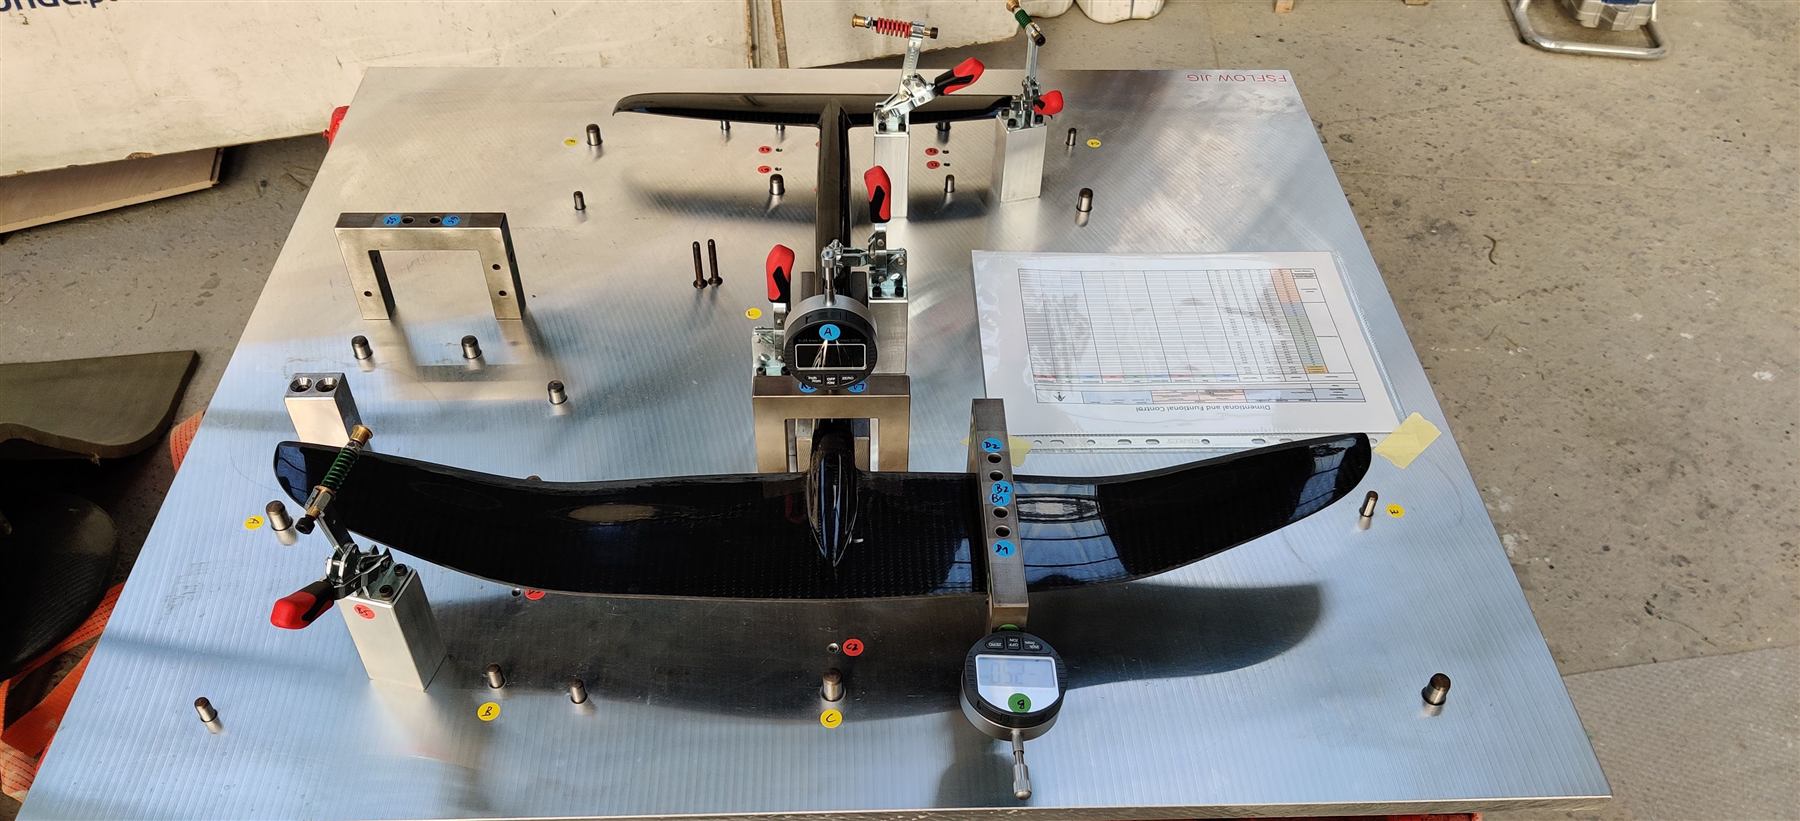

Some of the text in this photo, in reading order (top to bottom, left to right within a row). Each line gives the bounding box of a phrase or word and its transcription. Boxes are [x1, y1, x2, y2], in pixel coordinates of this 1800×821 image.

[1186, 74, 1287, 83] FSFLOW JIG
[983, 441, 1001, 450] D2
[994, 483, 1009, 494] B2
[991, 493, 1004, 503] B1
[845, 642, 860, 651] C2
